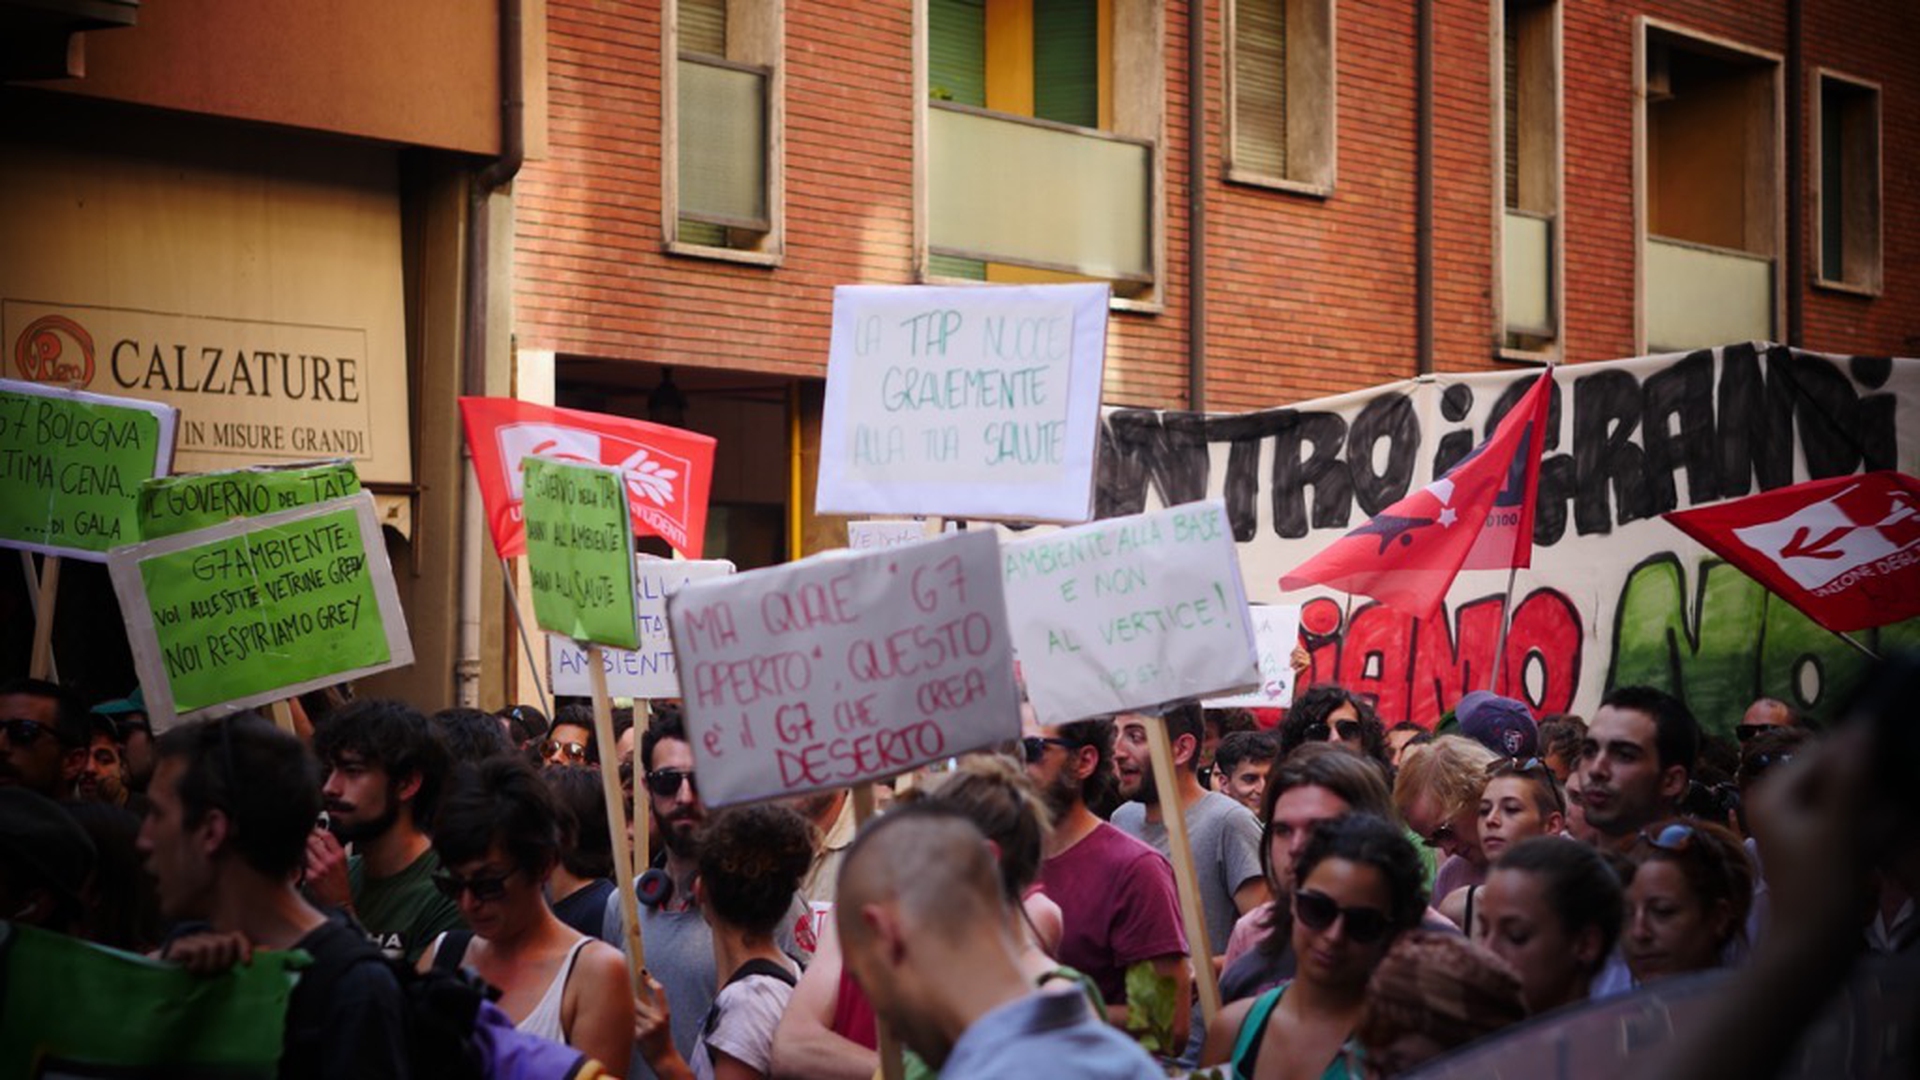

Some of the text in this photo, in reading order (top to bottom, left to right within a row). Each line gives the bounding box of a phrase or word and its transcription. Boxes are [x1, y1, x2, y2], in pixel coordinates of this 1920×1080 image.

[900, 309, 962, 356] TAP
[111, 339, 359, 403] CALZATURE
[882, 365, 1049, 412] GRAVEMENTE
[37, 402, 140, 452] BOLOGNA
[184, 420, 365, 455] IN MISURE GRANDI
[983, 420, 1066, 466] SALUTE
[168, 480, 270, 516] GOVERNO
[278, 491, 305, 508] DEL
[301, 467, 357, 501] TAP
[74, 511, 121, 540] GALA
[1004, 509, 1223, 583] AMBIENTE ALLA BASE
[155, 609, 180, 627] VOI
[191, 585, 260, 620] ALLESTITE
[265, 571, 326, 602] VETRINE
[1060, 566, 1147, 603] E NON
[165, 595, 361, 679] NOI RESPIRIAMO GREY
[683, 601, 738, 652] MA
[761, 574, 860, 636] QUALE
[848, 611, 992, 682] QUESTO
[1048, 628, 1081, 655] AL
[775, 702, 816, 745] G7
[833, 693, 879, 735] CHE
[916, 667, 988, 717] CREA
[774, 719, 946, 789] DESERTO
